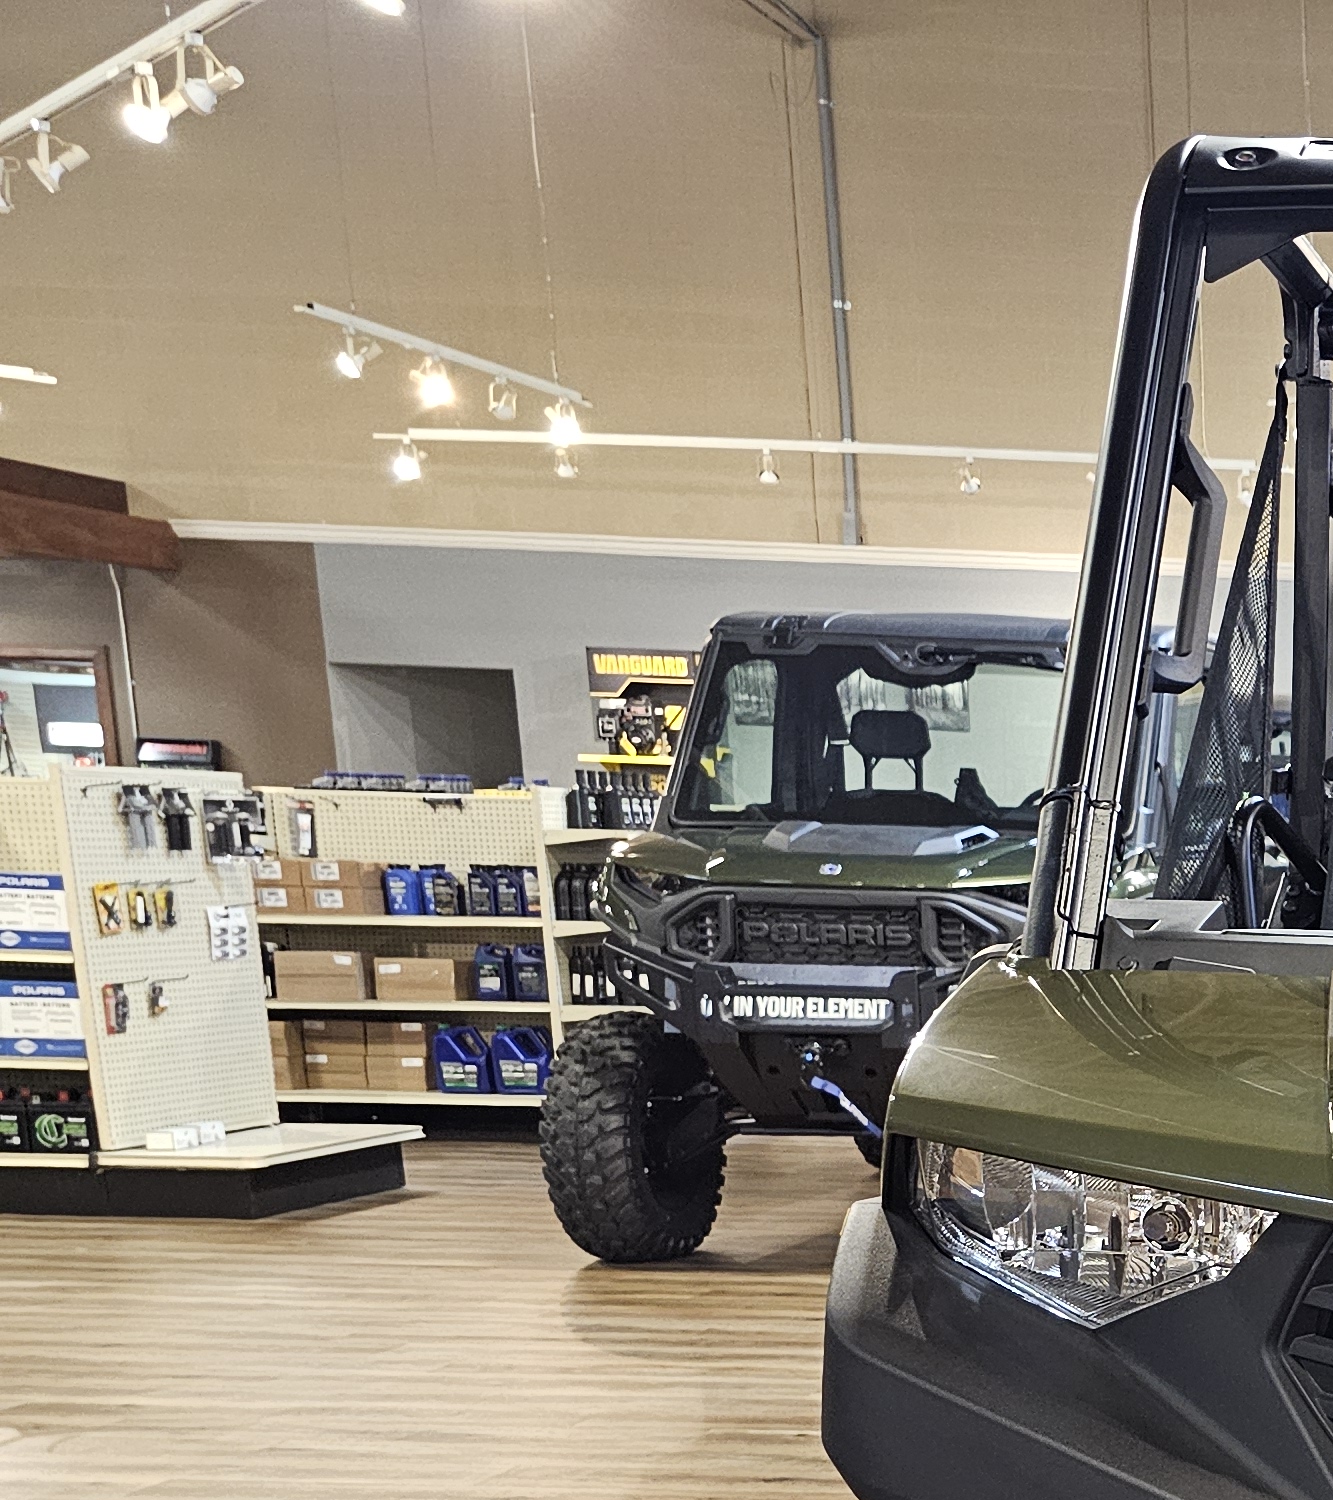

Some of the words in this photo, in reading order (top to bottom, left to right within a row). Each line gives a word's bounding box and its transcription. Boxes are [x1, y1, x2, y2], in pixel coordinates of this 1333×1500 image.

[592, 653, 689, 677] VANGUARD
[742, 921, 913, 947] POLARIS
[733, 995, 753, 1018] IN
[756, 995, 805, 1019] YOUR
[806, 996, 890, 1020] ELEMENT
